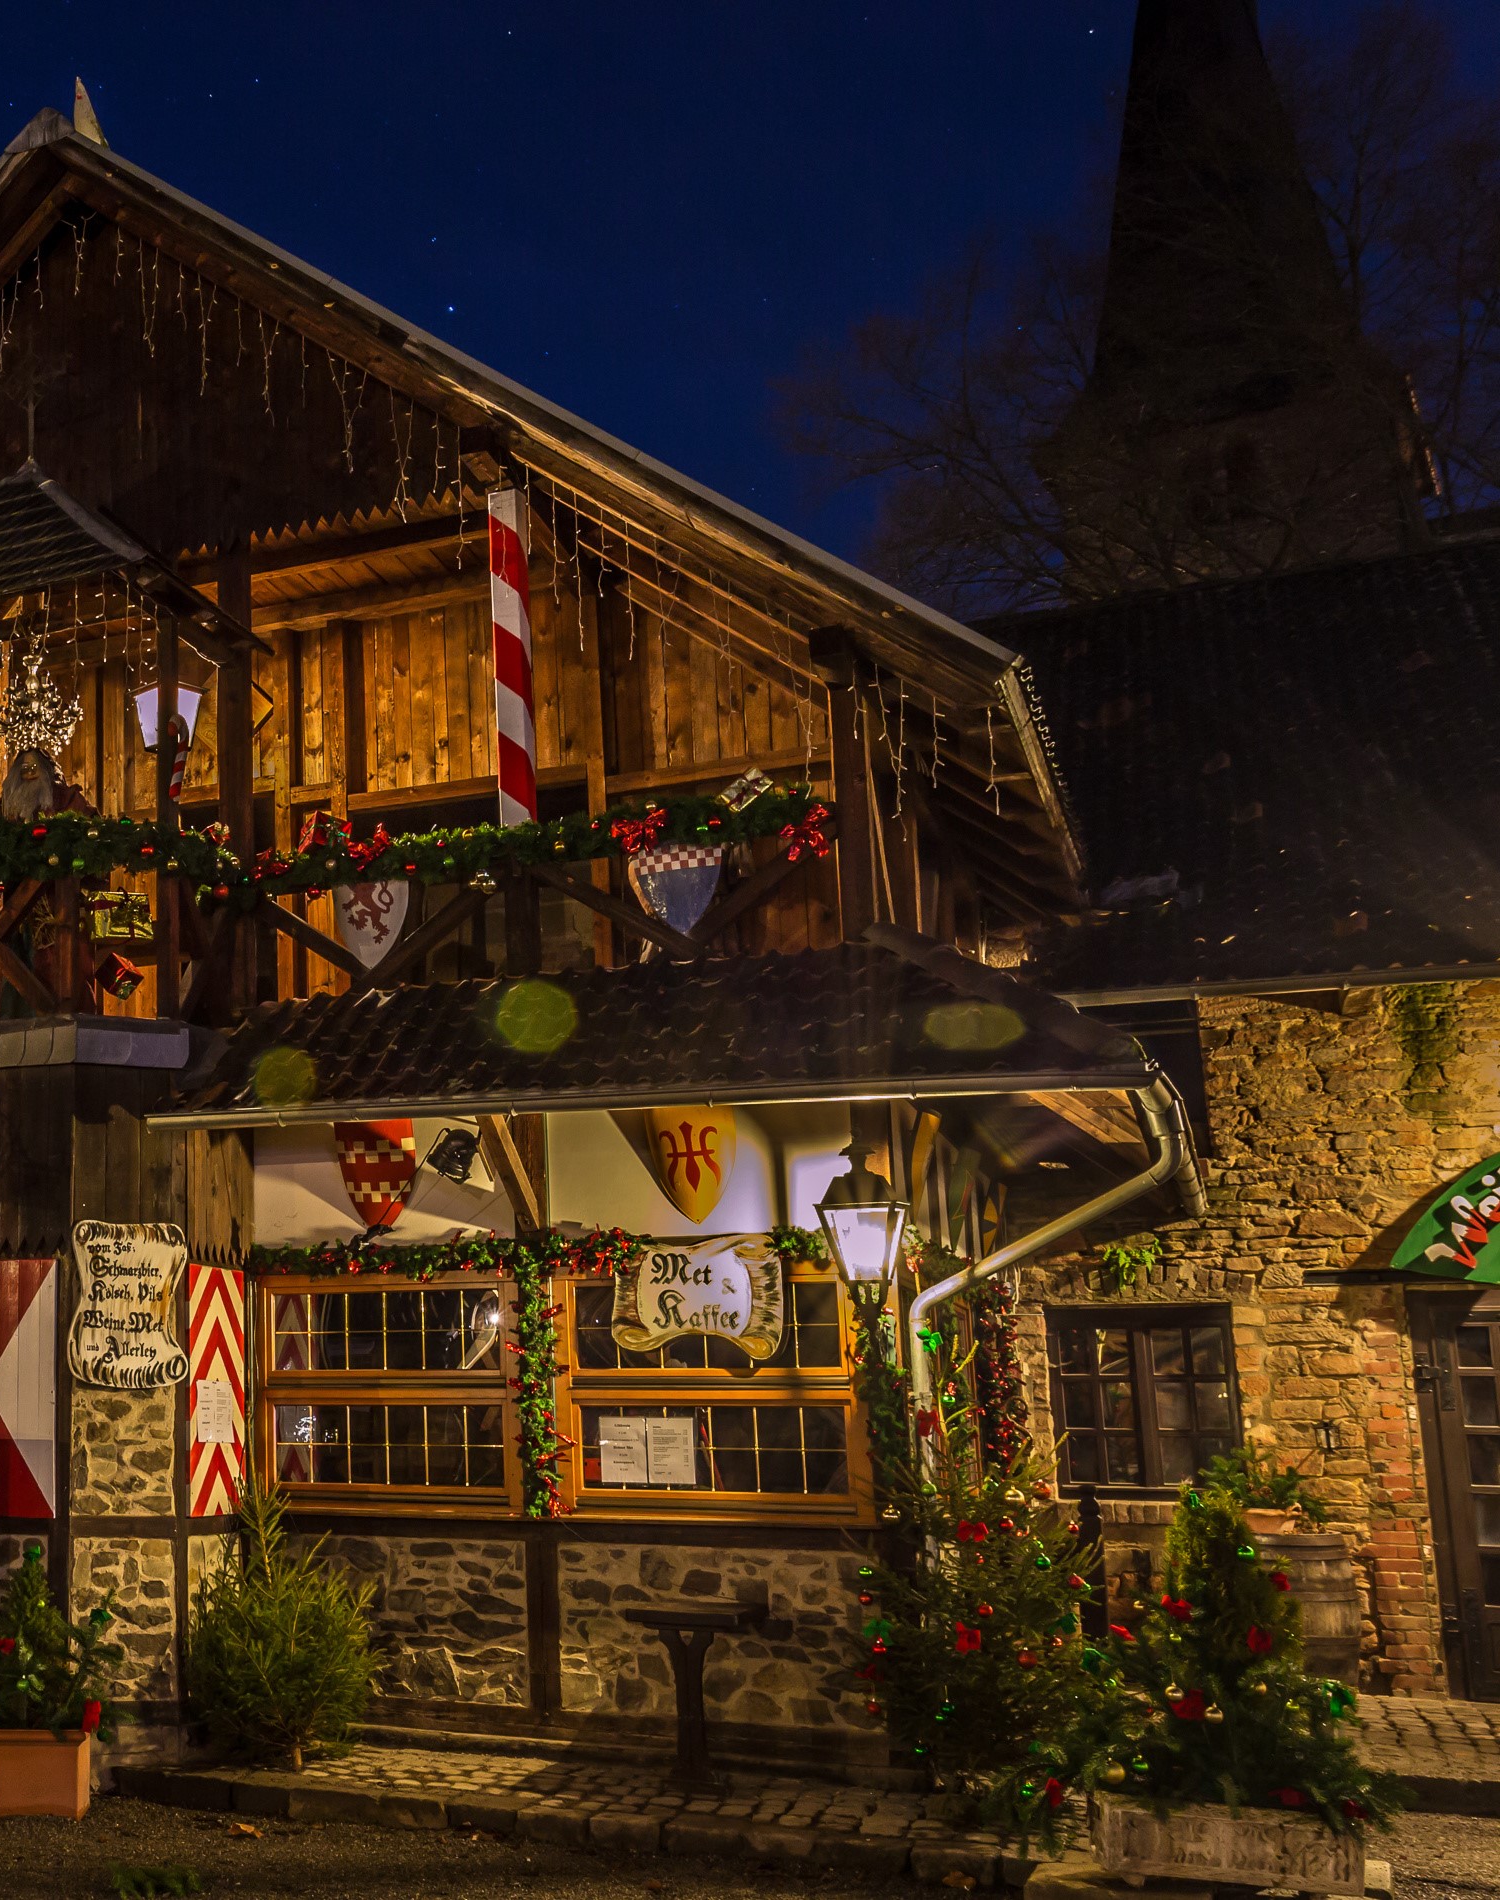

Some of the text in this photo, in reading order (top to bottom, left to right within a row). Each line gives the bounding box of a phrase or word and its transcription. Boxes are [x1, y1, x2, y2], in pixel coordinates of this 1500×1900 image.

[87, 1243, 111, 1253] vom
[650, 1252, 737, 1295] Met &
[88, 1280, 163, 1304] Kölsch, Pils
[128, 1312, 164, 1334] Met
[653, 1289, 740, 1331] Kaffee
[86, 1335, 157, 1363] und Allerley
